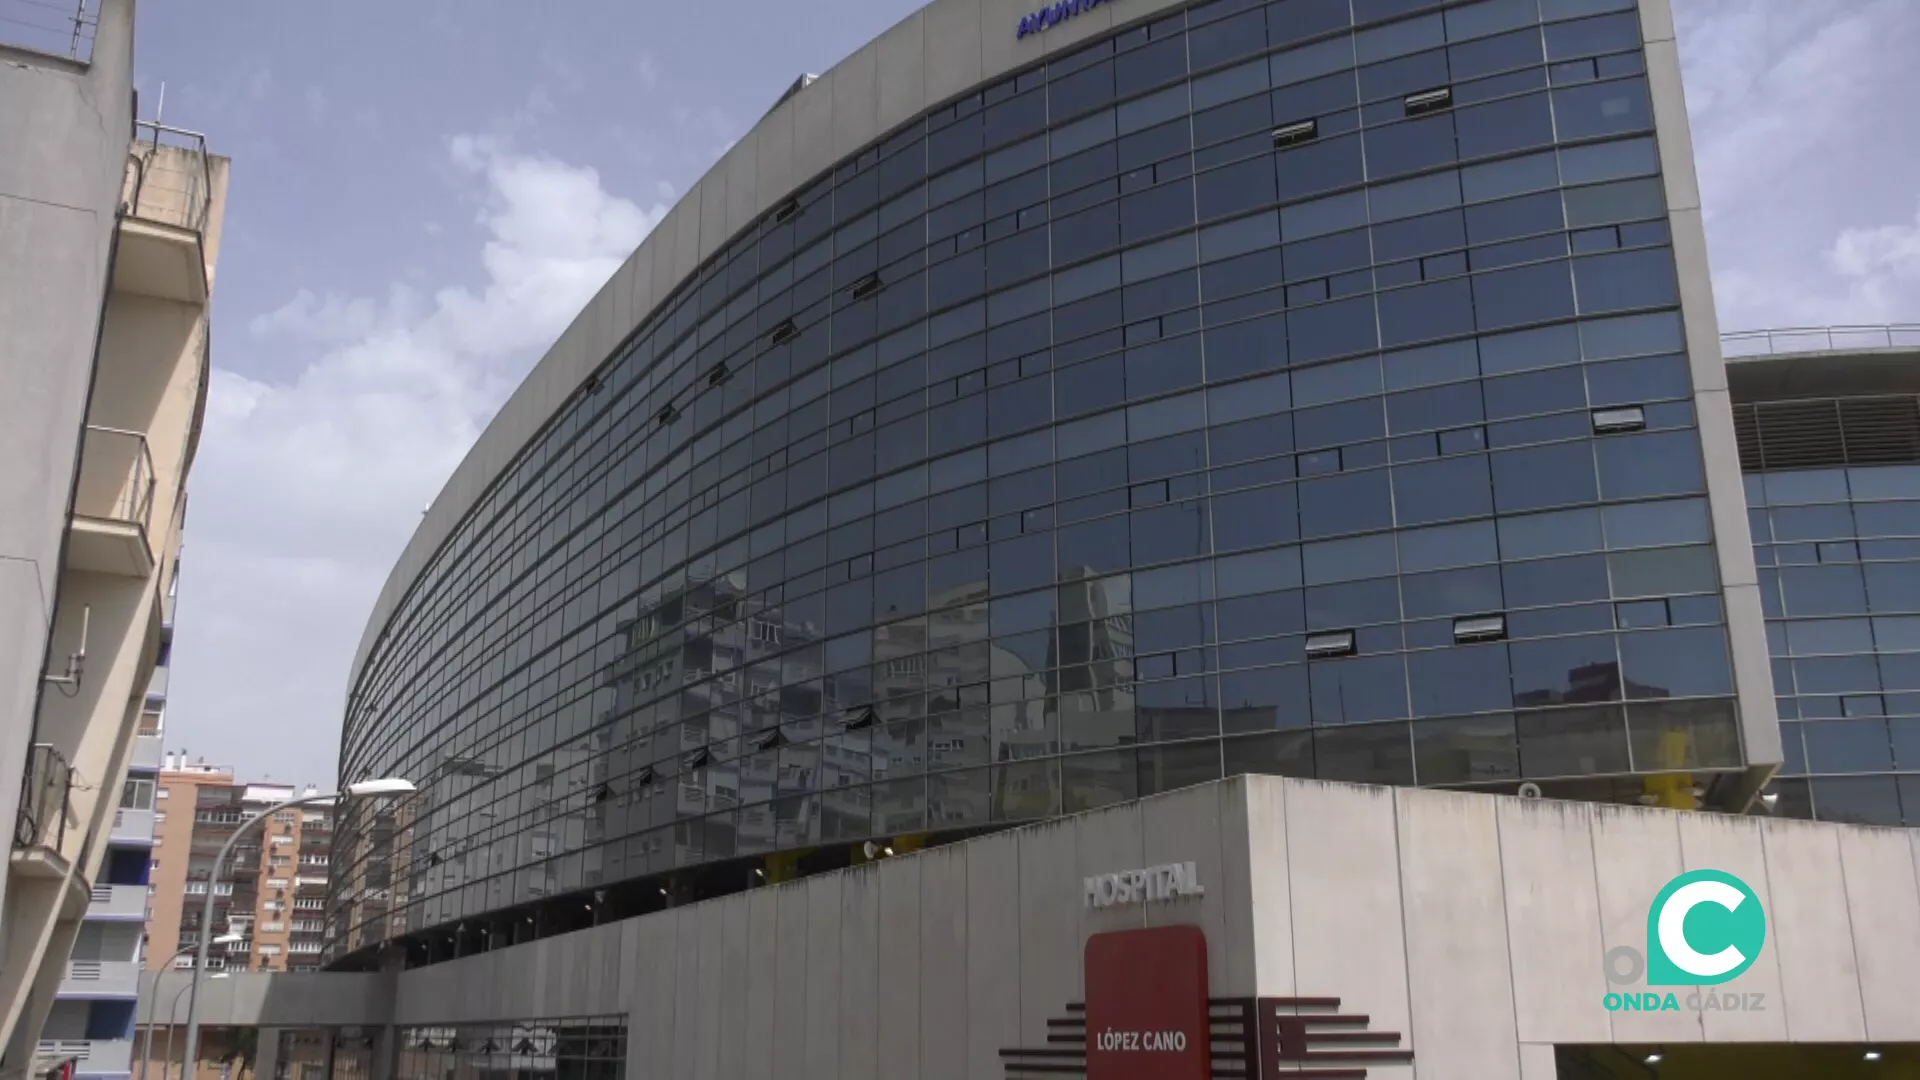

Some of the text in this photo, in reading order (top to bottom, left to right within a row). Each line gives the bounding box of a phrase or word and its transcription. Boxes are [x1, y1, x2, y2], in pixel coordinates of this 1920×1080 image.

[1016, 0, 1111, 40] AYUN
[1083, 861, 1205, 907] HOSPITAL
[1097, 1026, 1187, 1052] LÓPEZ CANO
